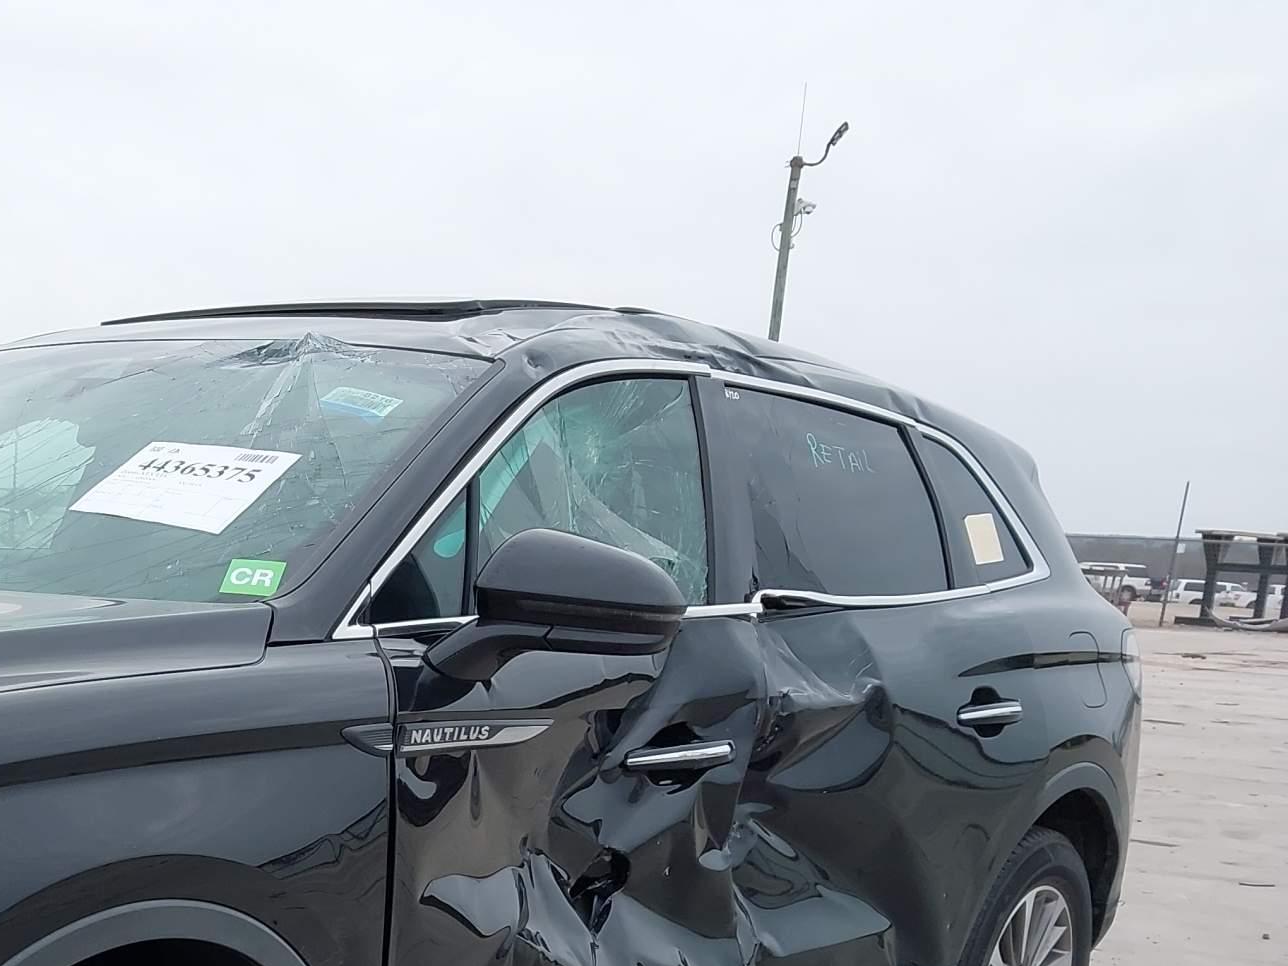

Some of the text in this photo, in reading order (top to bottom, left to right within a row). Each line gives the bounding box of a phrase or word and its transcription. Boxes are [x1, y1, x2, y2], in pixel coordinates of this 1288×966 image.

[806, 433, 877, 473] RETAIL
[139, 458, 262, 483] 44365375
[230, 567, 274, 587] CR
[411, 725, 490, 744] NAUTILUS
